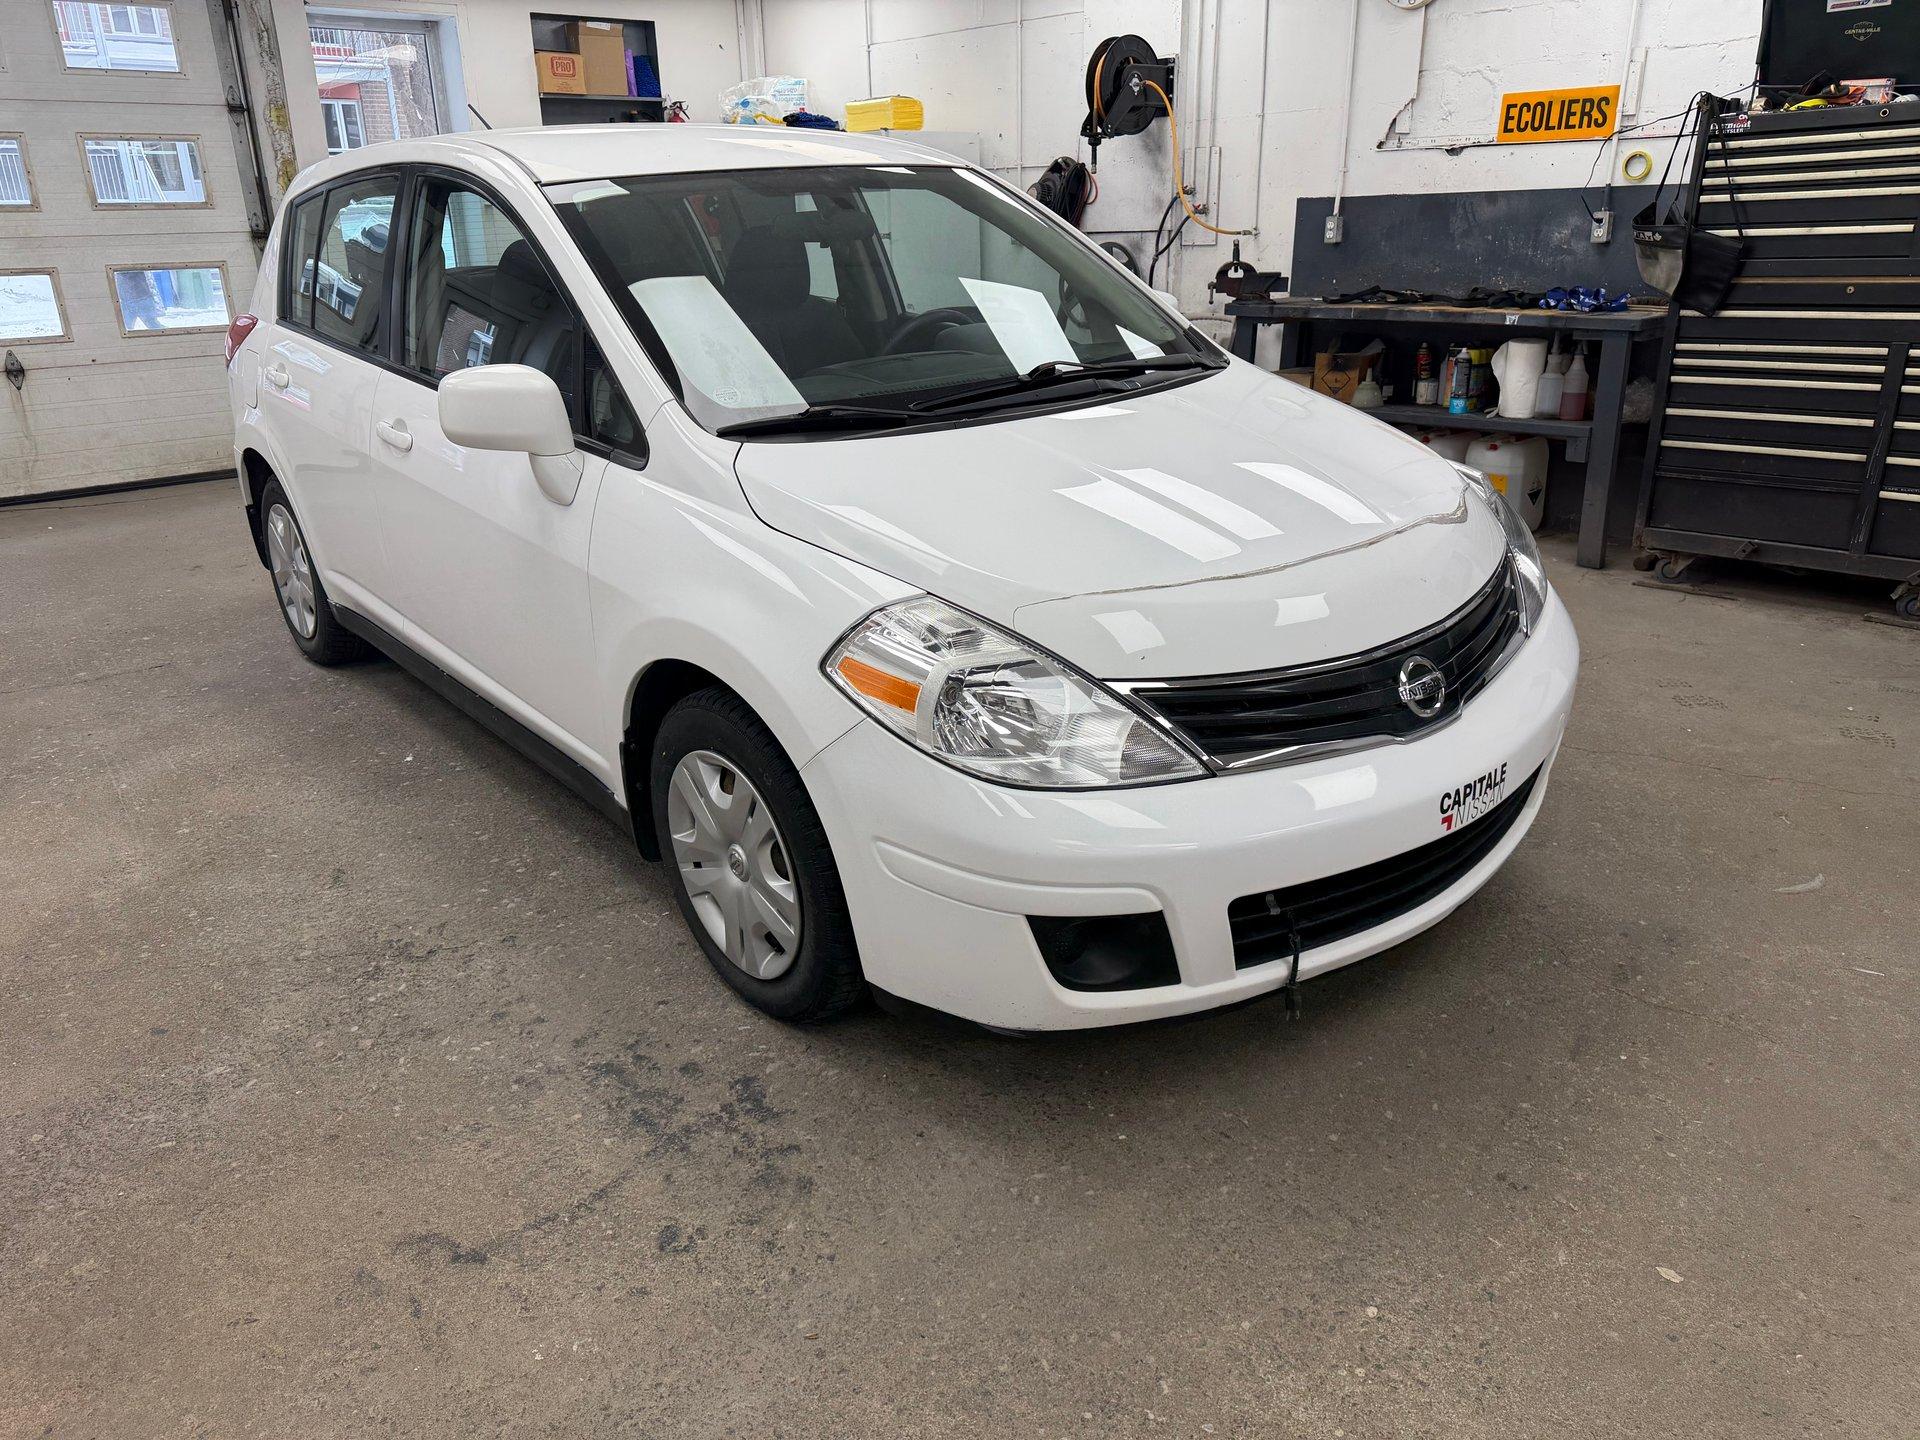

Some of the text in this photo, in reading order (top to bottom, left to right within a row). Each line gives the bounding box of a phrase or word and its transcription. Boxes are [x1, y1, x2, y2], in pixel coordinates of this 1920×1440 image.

[555, 61, 571, 72] PRO
[1503, 96, 1610, 133] ECOLIERS
[1440, 762, 1507, 815] CAPITALE
[1455, 781, 1506, 828] NISSAN
